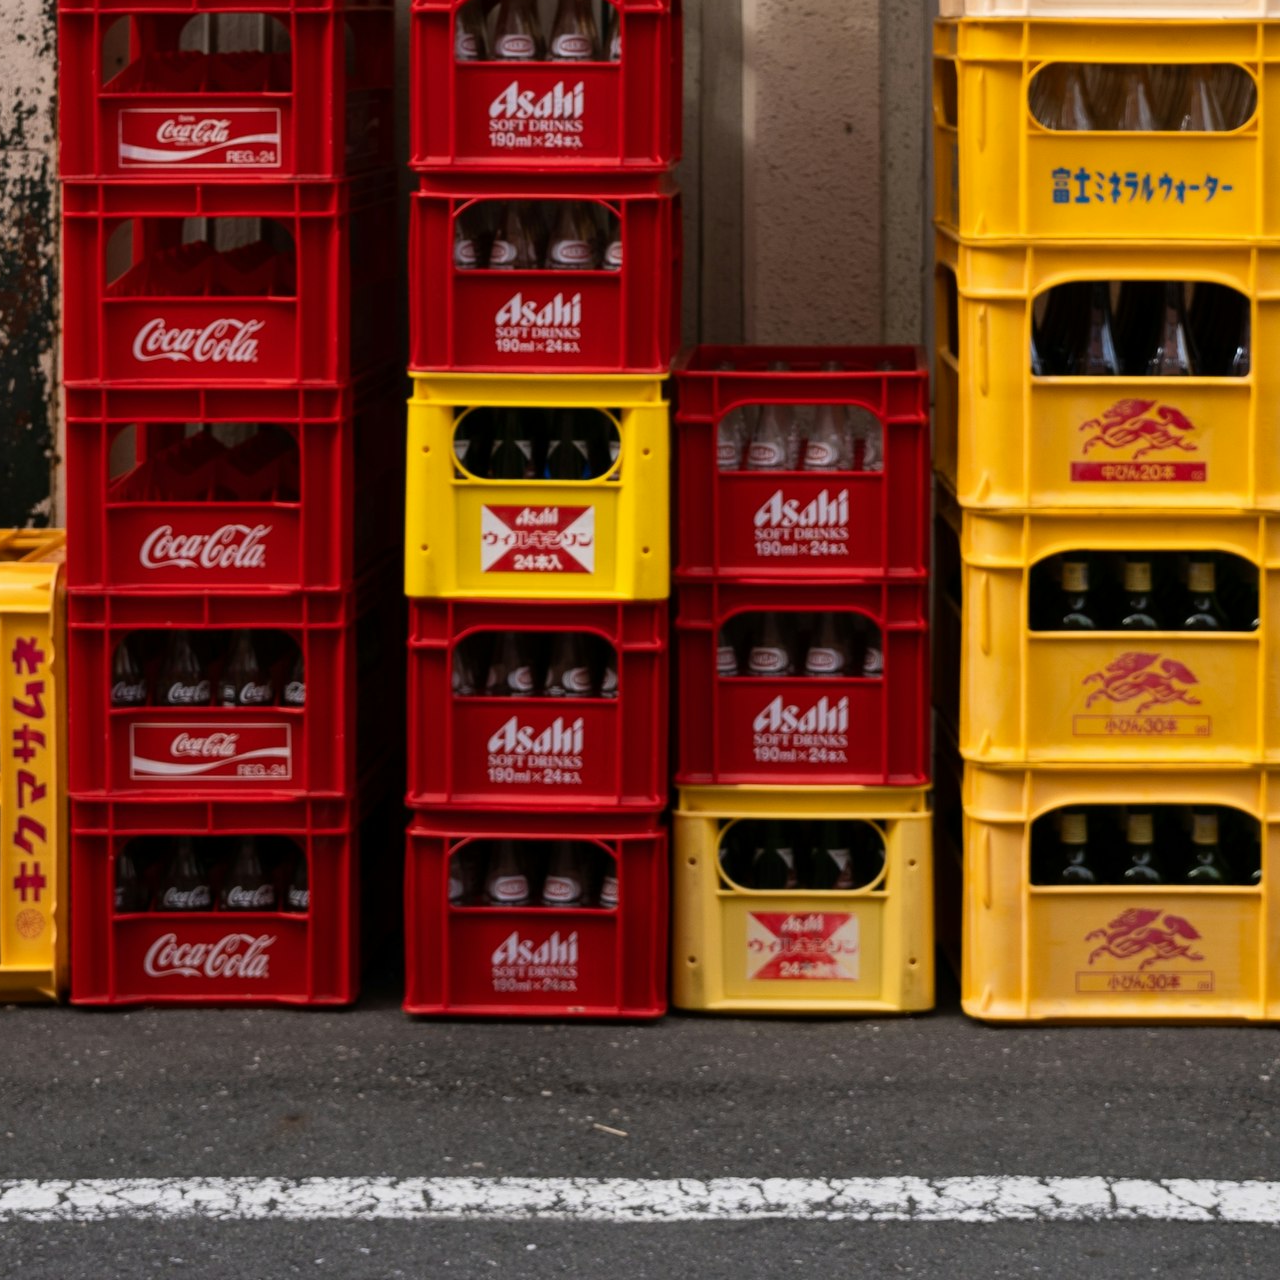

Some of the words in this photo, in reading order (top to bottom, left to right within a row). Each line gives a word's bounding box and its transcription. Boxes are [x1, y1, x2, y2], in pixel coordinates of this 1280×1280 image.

[488, 80, 584, 119] Asahi
[156, 118, 232, 144] Coca-Cola
[489, 119, 526, 132] SOFT
[528, 119, 584, 132] DRINKS
[1051, 166, 1233, 205] 富士ミネラルウォーター
[495, 291, 581, 327] Asahi
[132, 318, 265, 362] Coca-Cola
[495, 326, 530, 339] SOFT
[531, 326, 581, 340] DRINKS
[515, 506, 559, 526] Asahi
[753, 488, 849, 528] Asahi
[140, 523, 273, 569] Coca-Cola
[754, 527, 790, 540] SOFT
[792, 527, 849, 540] DRINKS
[513, 553, 563, 572] 24本入
[752, 694, 849, 733] Asahi
[170, 732, 240, 757] Coca-Cola
[487, 716, 584, 755] Asahi
[753, 733, 789, 748] SOFT
[791, 733, 849, 748] DRINKS
[11, 636, 47, 902] キクマサムネ
[487, 754, 525, 768] SOFT
[527, 754, 584, 769] DRINKS
[781, 914, 825, 933] Asahi
[144, 932, 277, 979] Coca-Cola
[491, 930, 578, 965] Asahi
[491, 965, 526, 979] SOFT
[528, 965, 578, 979] DRINKS
